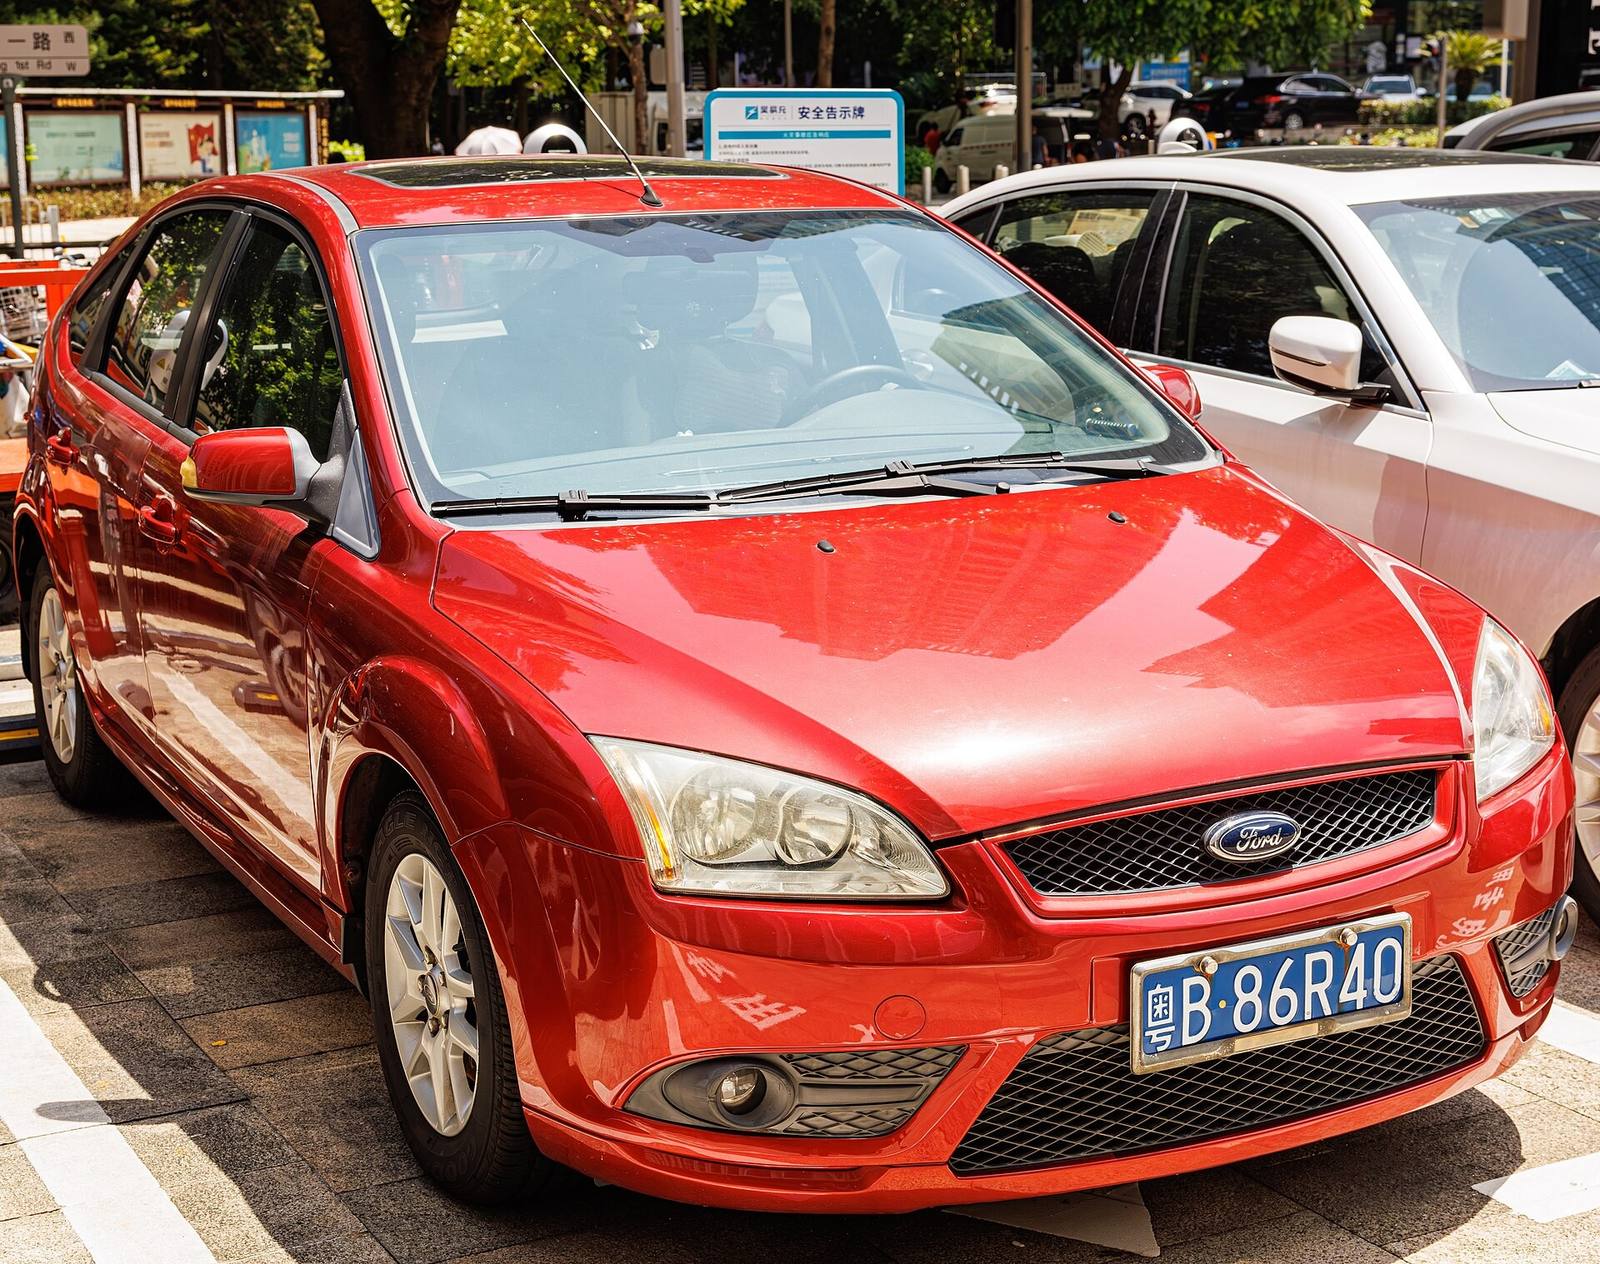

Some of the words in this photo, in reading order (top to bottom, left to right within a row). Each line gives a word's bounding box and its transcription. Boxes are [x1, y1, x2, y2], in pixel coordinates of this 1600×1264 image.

[8, 31, 50, 51] 一路
[37, 60, 52, 70] Rd
[66, 61, 77, 71] W
[798, 106, 865, 119] 安全告示牌
[1236, 824, 1282, 852] Ford
